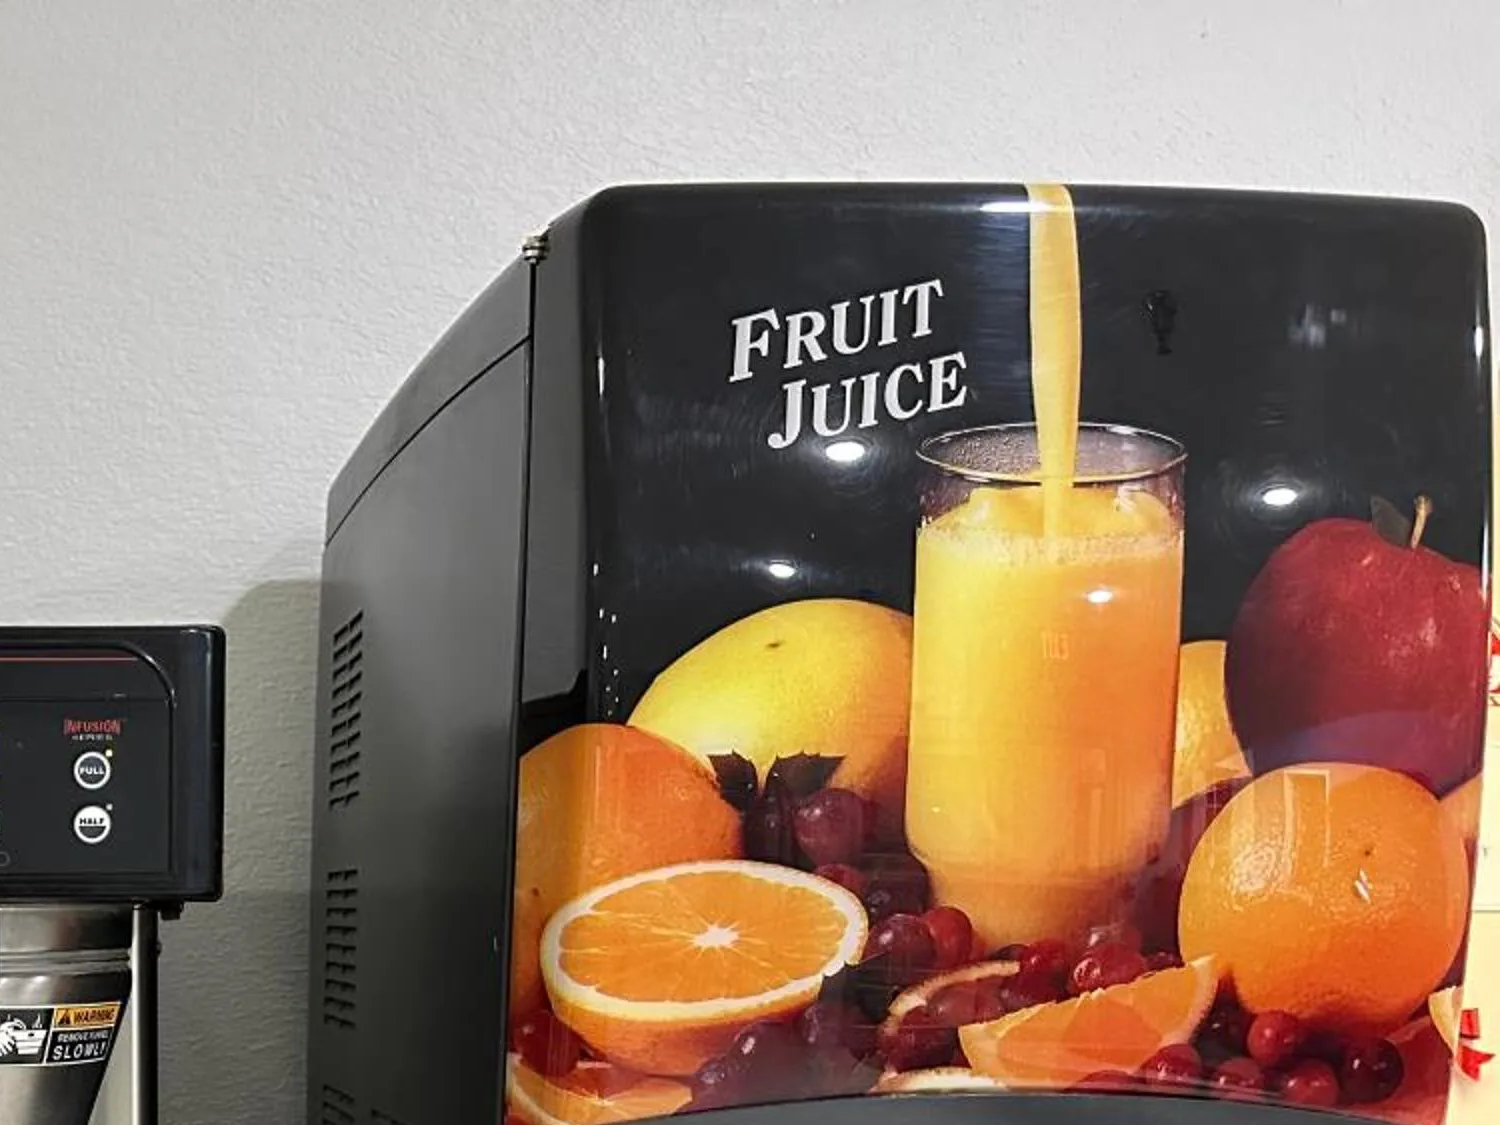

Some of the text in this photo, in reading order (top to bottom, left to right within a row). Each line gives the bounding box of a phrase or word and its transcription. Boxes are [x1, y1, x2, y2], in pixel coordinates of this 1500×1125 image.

[729, 279, 944, 382] FRUIT
[767, 351, 968, 450] JUICE
[63, 719, 120, 735] INFUSION
[79, 766, 105, 774] FULL
[79, 817, 105, 825] HALF
[73, 1008, 115, 1021] WARNING
